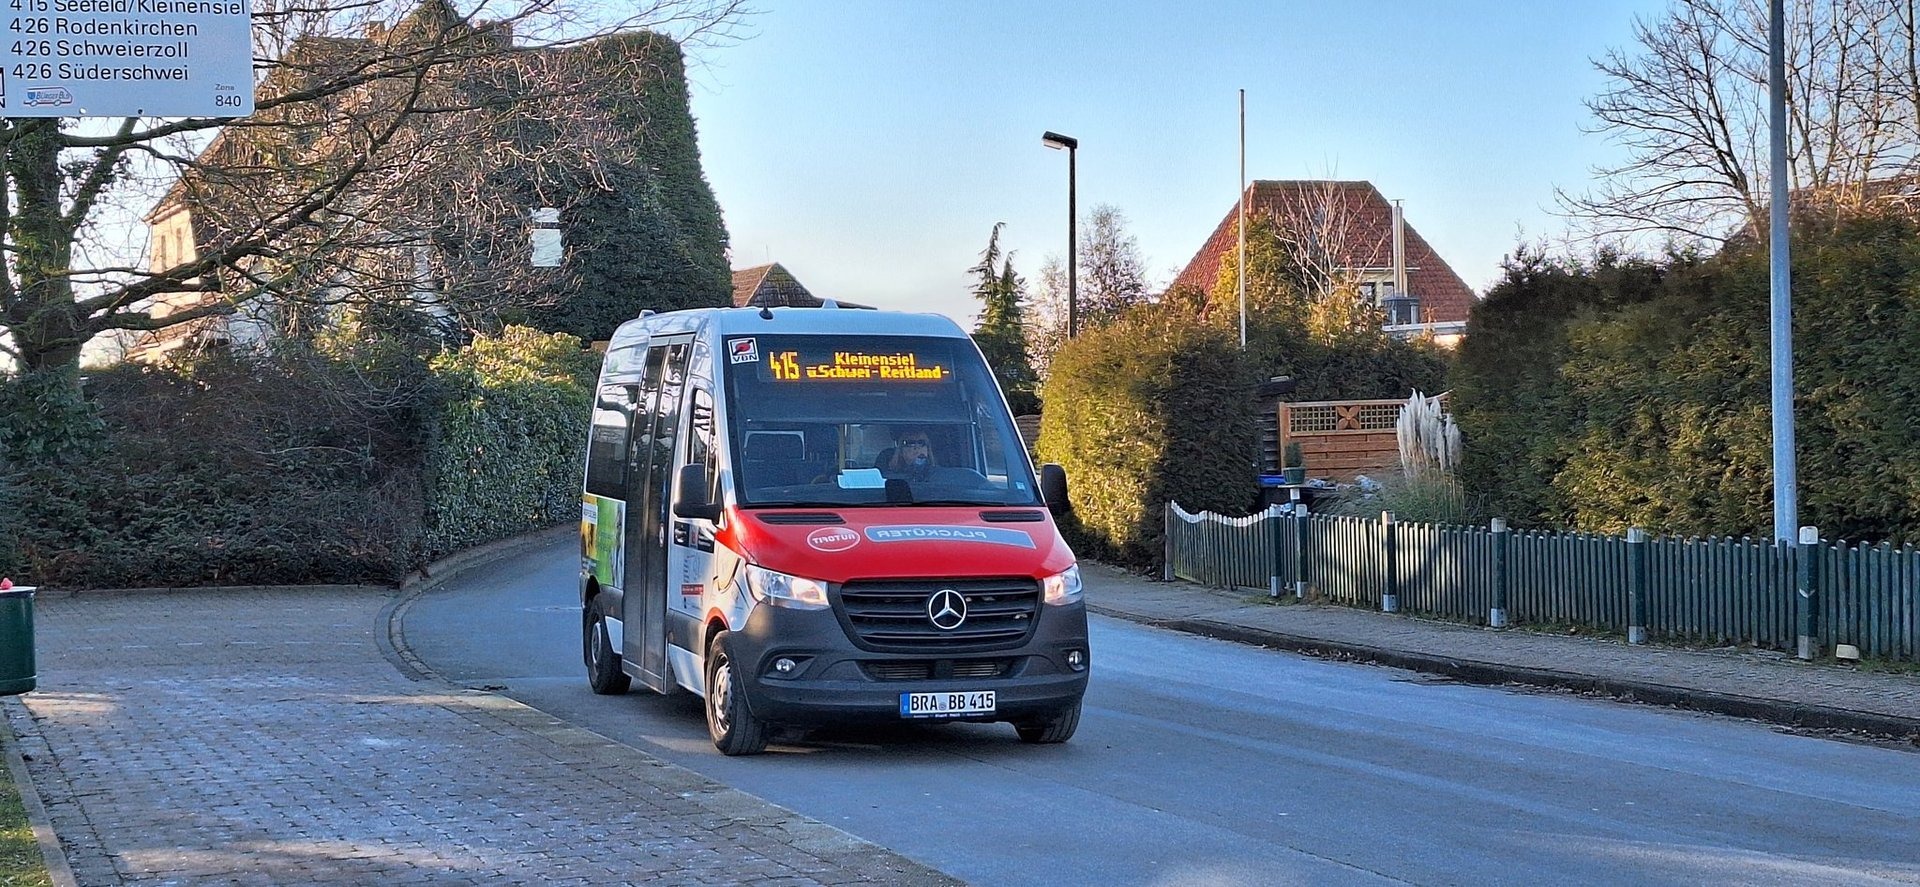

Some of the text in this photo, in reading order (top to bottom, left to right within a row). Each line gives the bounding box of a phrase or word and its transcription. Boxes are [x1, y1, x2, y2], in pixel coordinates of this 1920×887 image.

[9, 0, 246, 15] 415 Seefeld/Kleinensiel
[10, 17, 198, 36] 426 Rodenkirchen
[11, 39, 188, 58] 426 Schweierzoll
[13, 62, 188, 81] 426 Süderschwei
[215, 95, 241, 107] 840
[732, 354, 757, 362] VBN
[769, 351, 799, 379] 415
[834, 352, 915, 366] Kleinensiel
[911, 693, 994, 711] BRA BB 415
